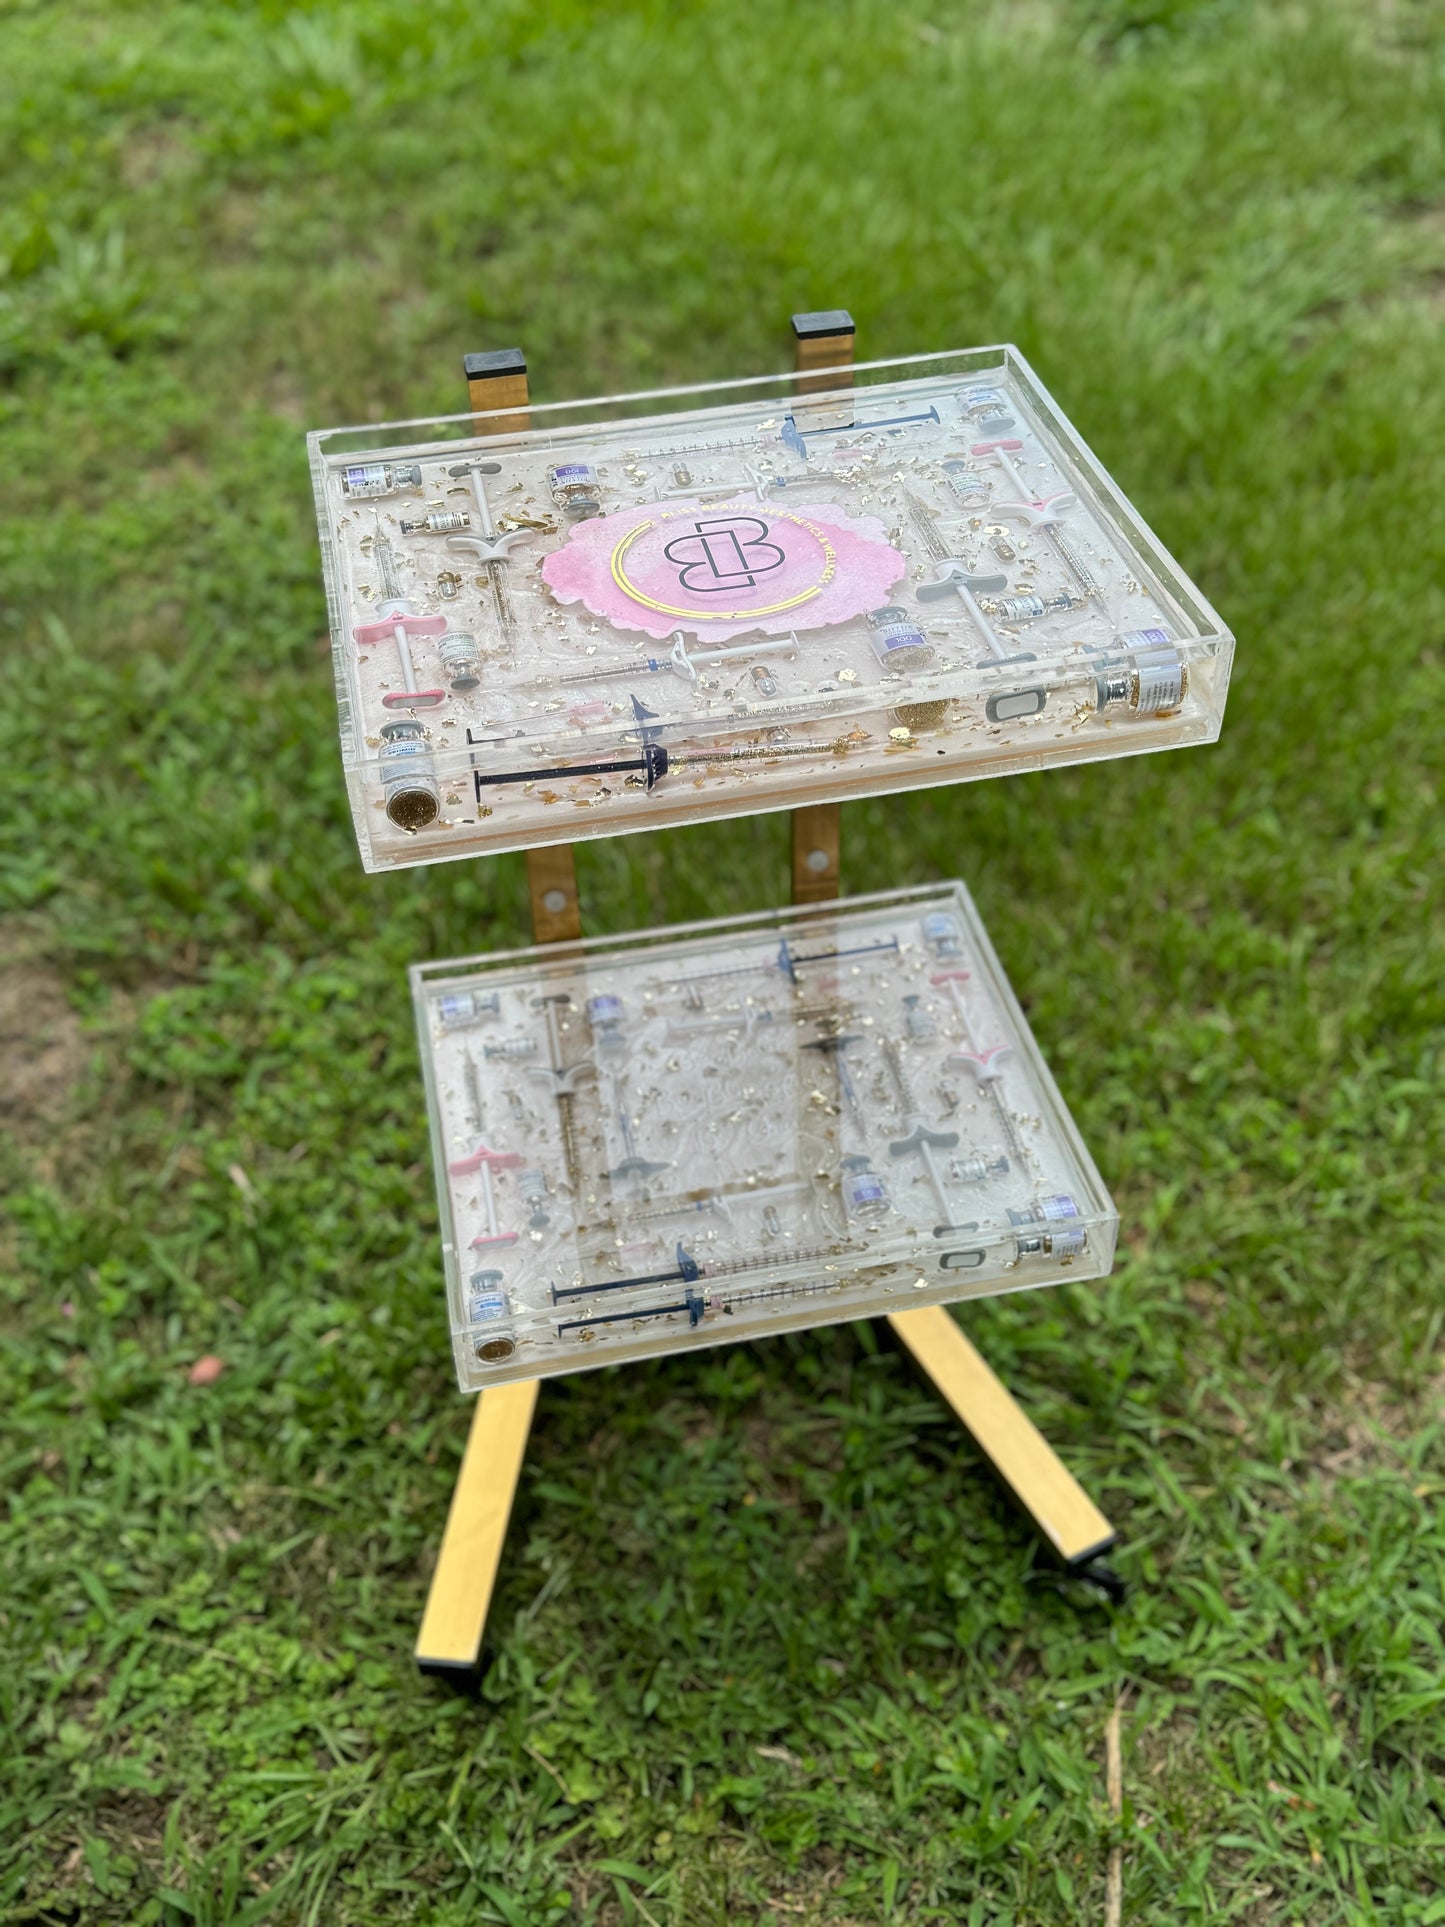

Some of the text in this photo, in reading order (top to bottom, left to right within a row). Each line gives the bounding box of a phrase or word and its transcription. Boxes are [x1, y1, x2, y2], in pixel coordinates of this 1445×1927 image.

[661, 506, 697, 519] BLISS
[701, 503, 757, 512] BEAUTY
[760, 507, 825, 537] AESTHETICS
[819, 543, 837, 584] WELLNESS
[896, 635, 913, 643] 100
